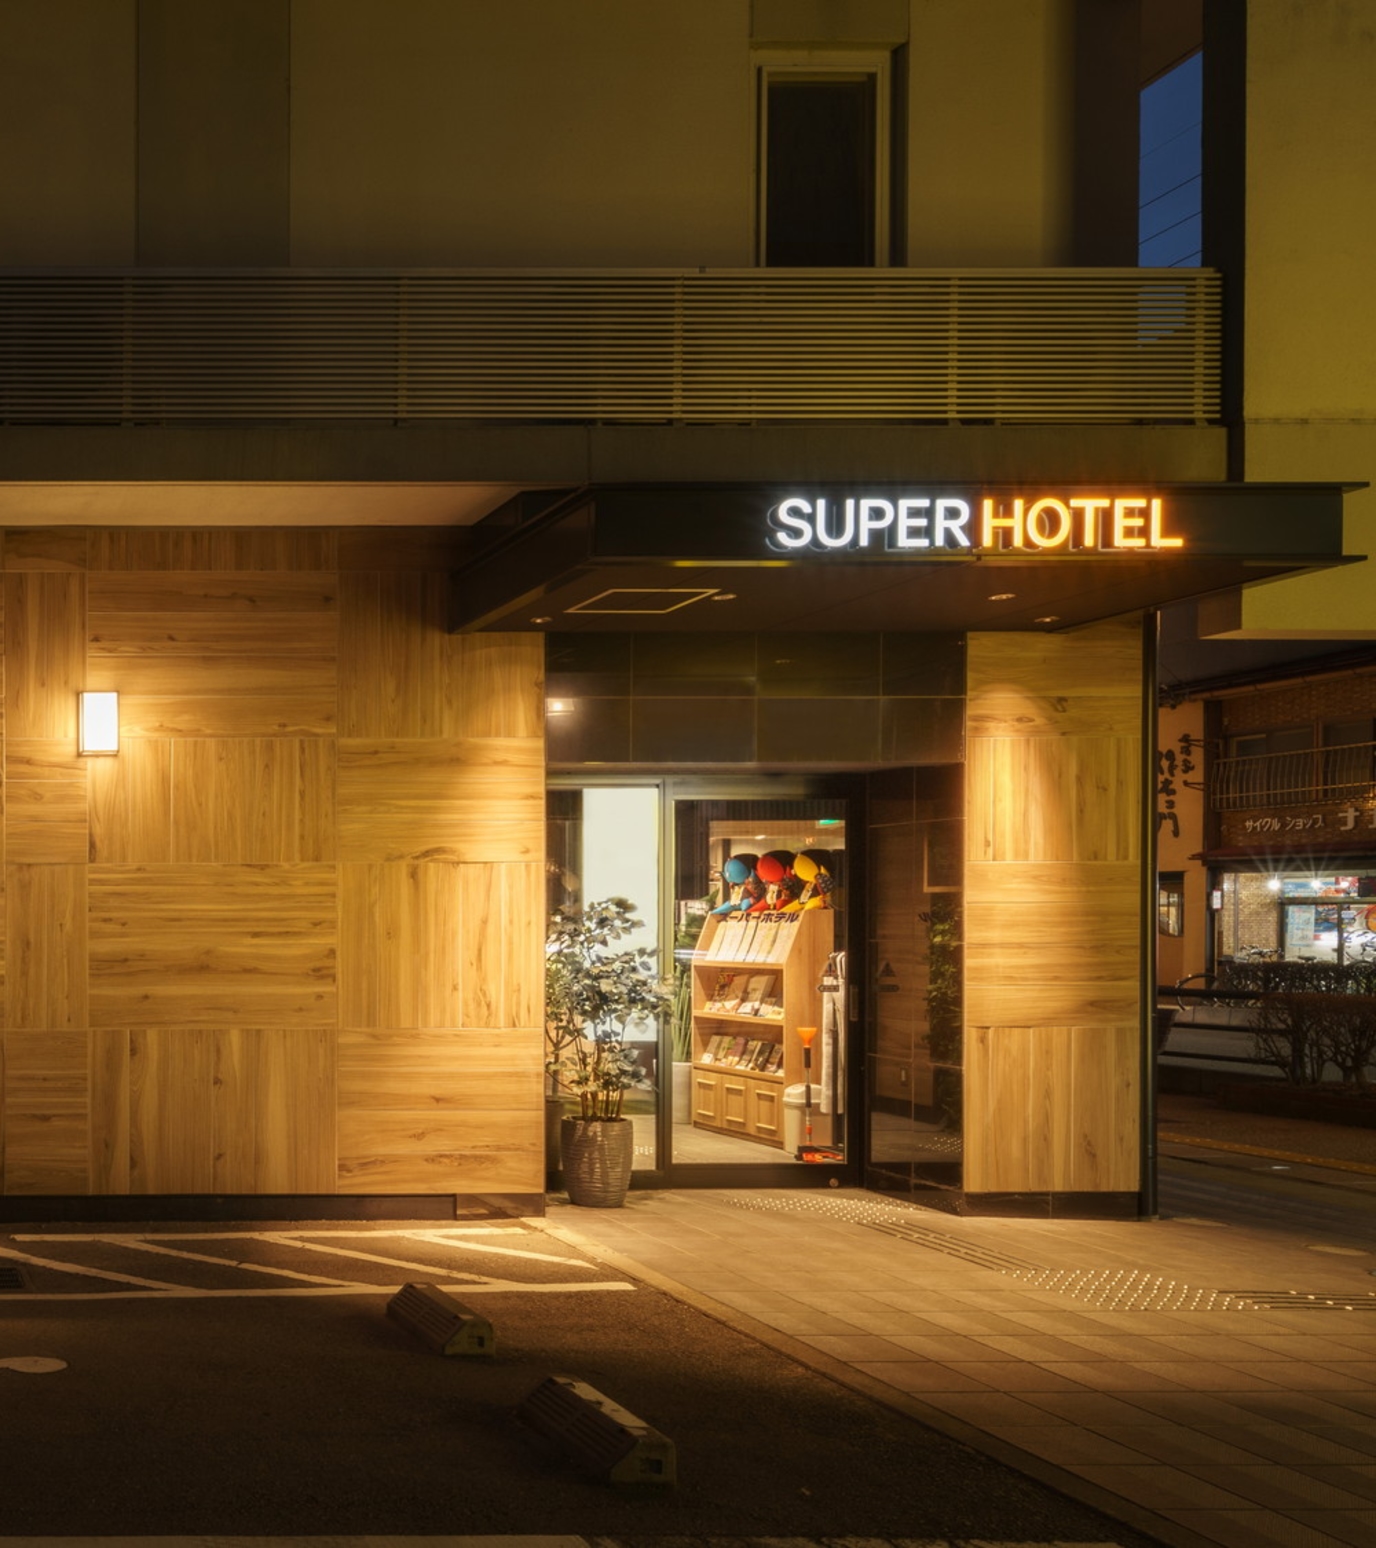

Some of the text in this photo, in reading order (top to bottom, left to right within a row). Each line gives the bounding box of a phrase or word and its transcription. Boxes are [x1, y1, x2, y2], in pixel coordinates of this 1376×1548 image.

[777, 498, 1184, 548] SUPER HOTEL
[1245, 818, 1281, 832] サイクル
